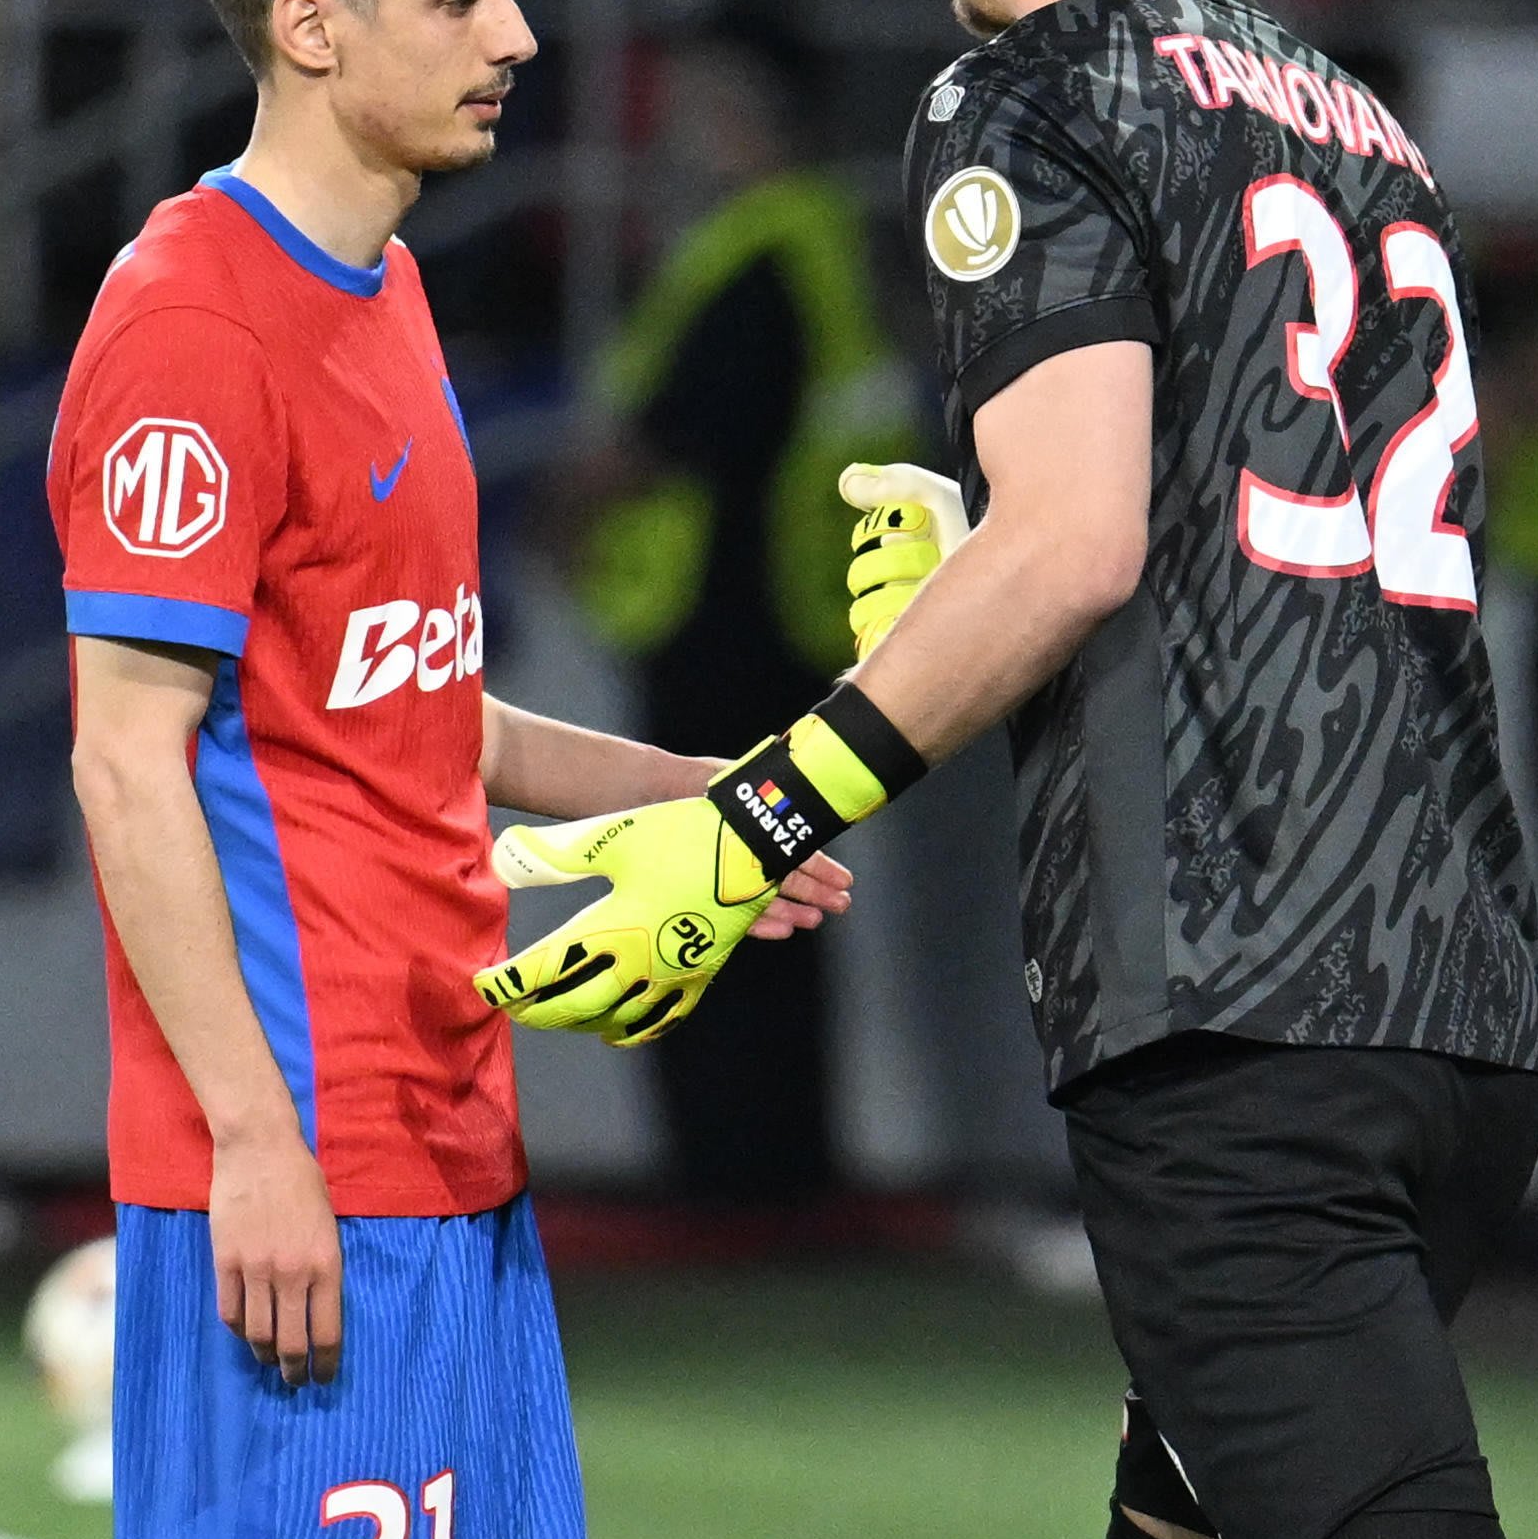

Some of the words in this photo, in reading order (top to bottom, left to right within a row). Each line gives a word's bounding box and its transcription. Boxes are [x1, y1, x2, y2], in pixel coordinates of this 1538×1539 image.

[1153, 33, 1438, 193] TARNOVAN
[1237, 171, 1480, 616] 32
[113, 430, 216, 546] MG
[325, 582, 483, 710] Beta
[734, 782, 798, 858] TARNO
[786, 812, 813, 841] 32
